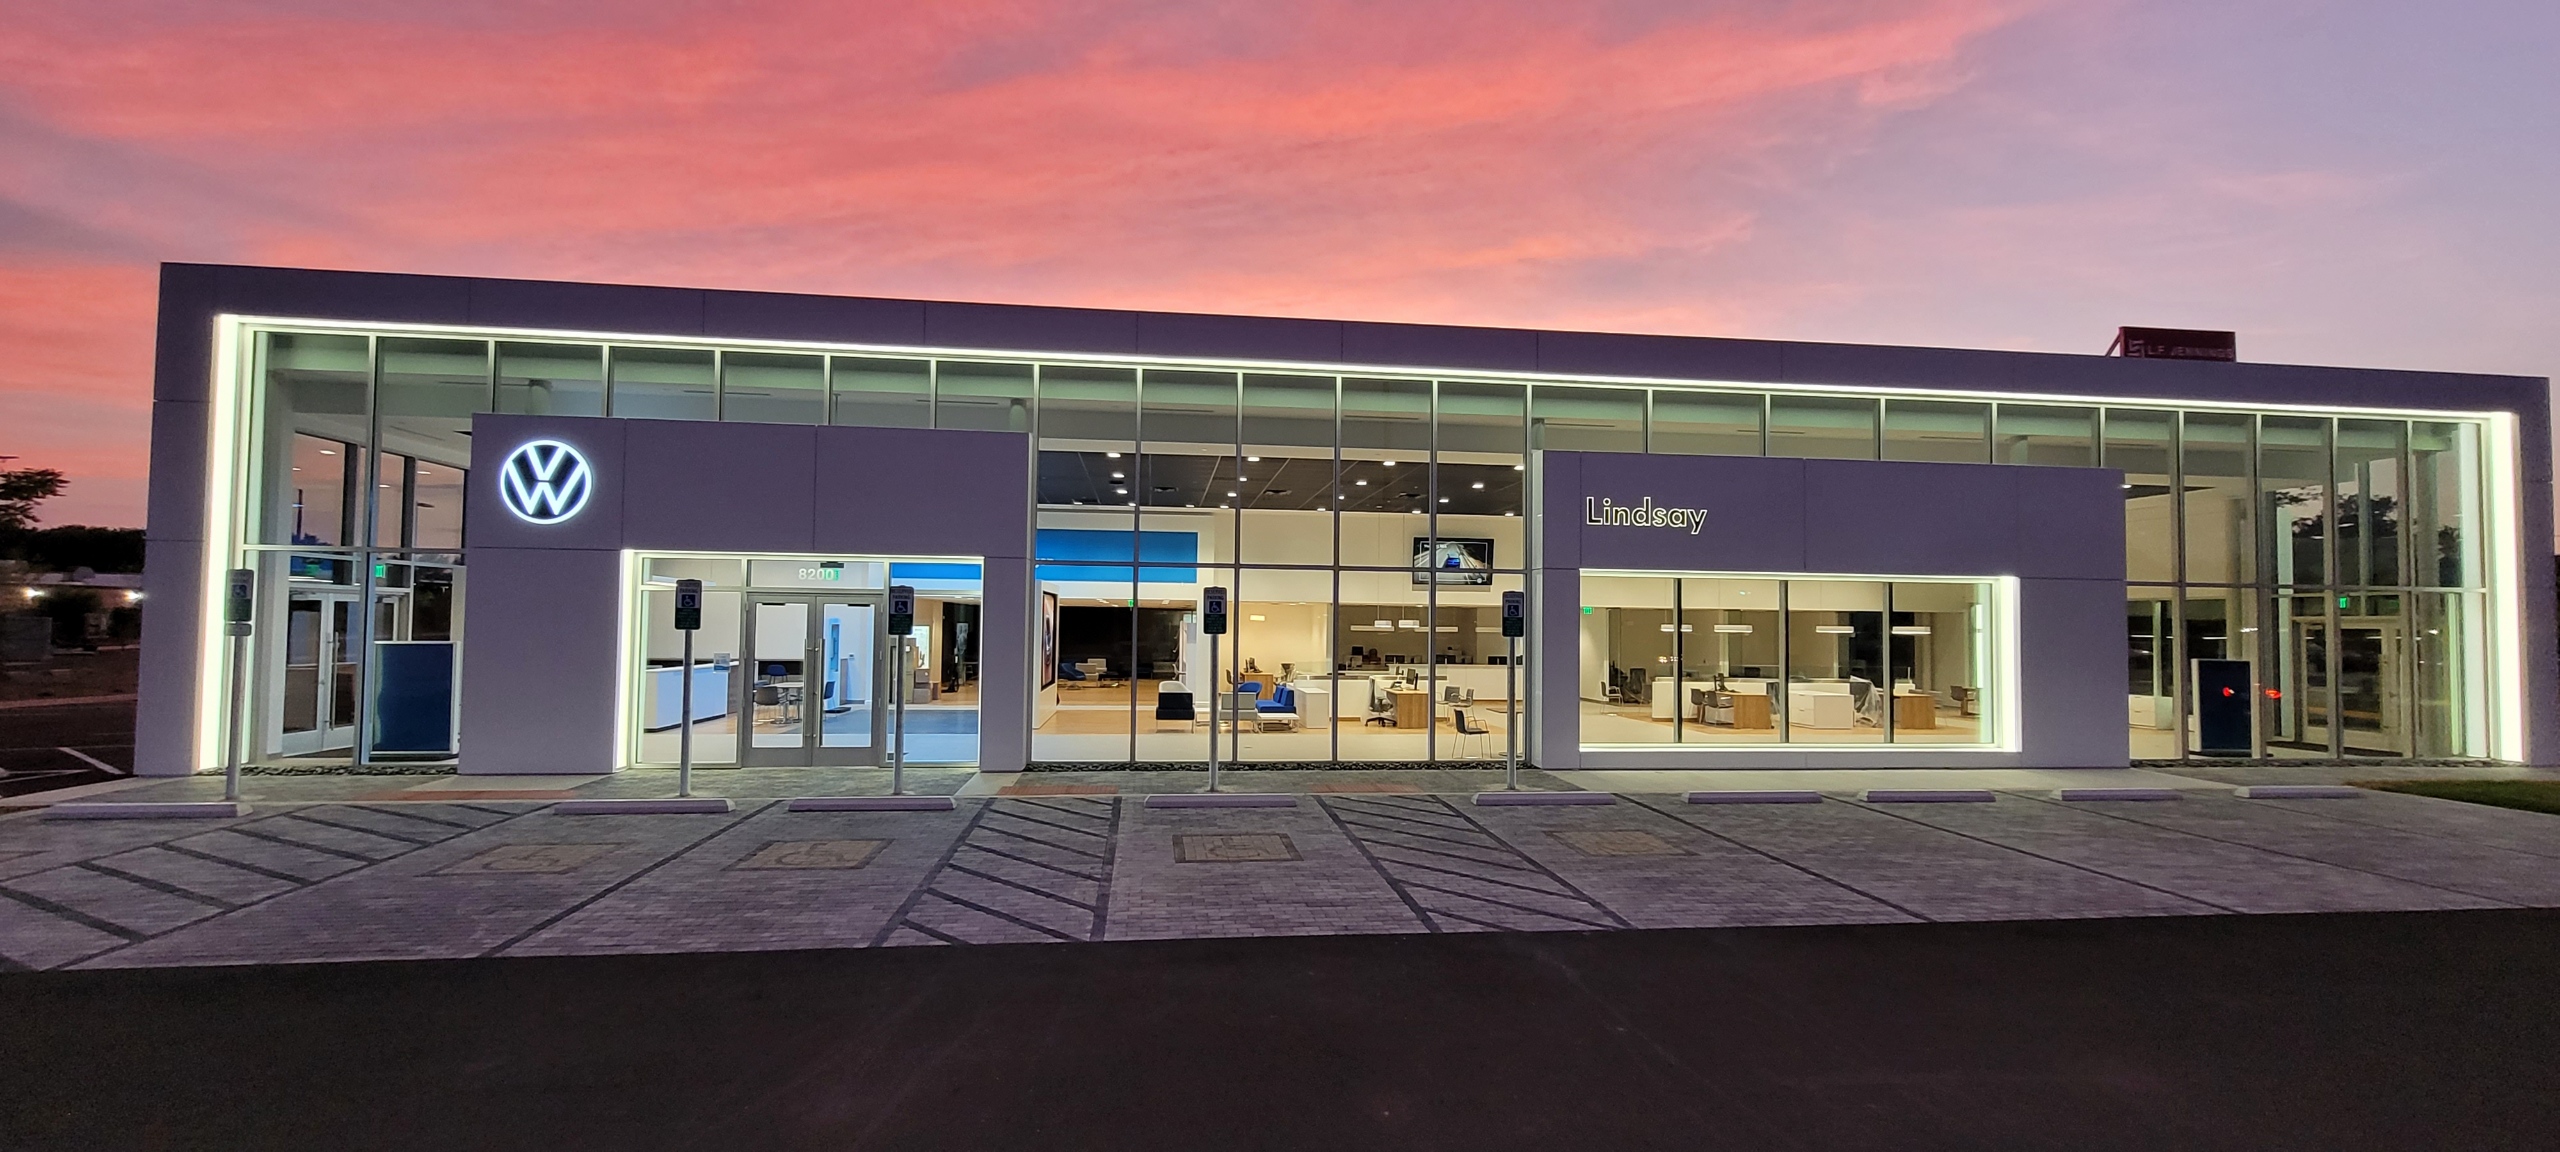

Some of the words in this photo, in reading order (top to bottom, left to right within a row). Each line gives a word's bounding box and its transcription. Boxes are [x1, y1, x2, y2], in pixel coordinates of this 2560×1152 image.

[503, 443, 588, 519] VW
[1586, 496, 1708, 535] Lindsay
[798, 568, 835, 580] 8200
